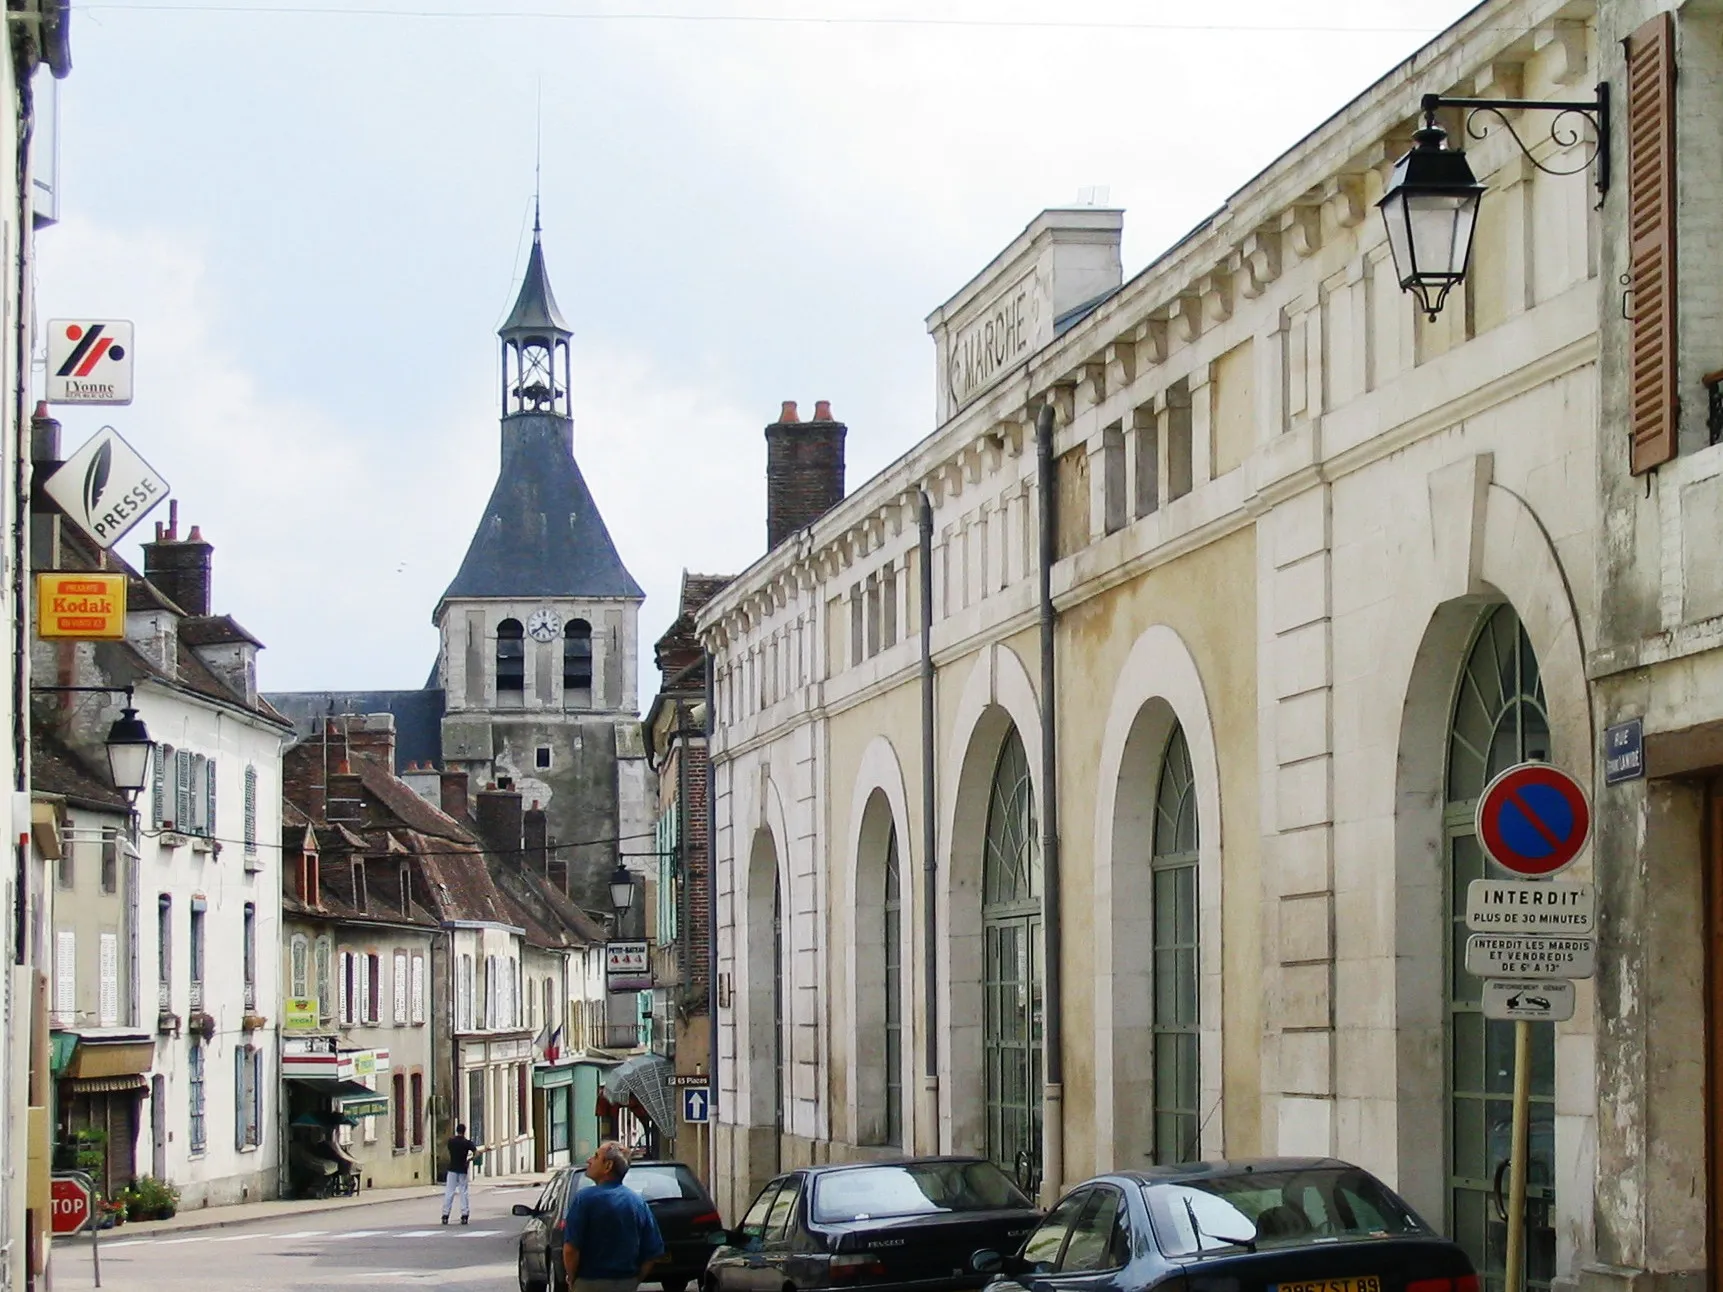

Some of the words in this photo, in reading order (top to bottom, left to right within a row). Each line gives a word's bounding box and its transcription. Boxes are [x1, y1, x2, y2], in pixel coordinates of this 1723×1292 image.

[94, 478, 157, 539] PRESSE
[53, 598, 112, 613] Kodak
[1484, 890, 1579, 905] INTERDIT
[1474, 913, 1501, 922] PLUS
[1505, 913, 1518, 923] DE
[1522, 914, 1536, 923] 30
[1540, 914, 1587, 924] MINUTES
[1475, 940, 1522, 949] INTERDIT
[1526, 941, 1544, 950] LES
[1549, 941, 1590, 951] MARDIS
[1490, 951, 1503, 960] ET
[1508, 951, 1574, 962] VENDREDIS
[1502, 963, 1515, 971] DE
[1534, 963, 1541, 972] A
[51, 1199, 84, 1214] TOP
